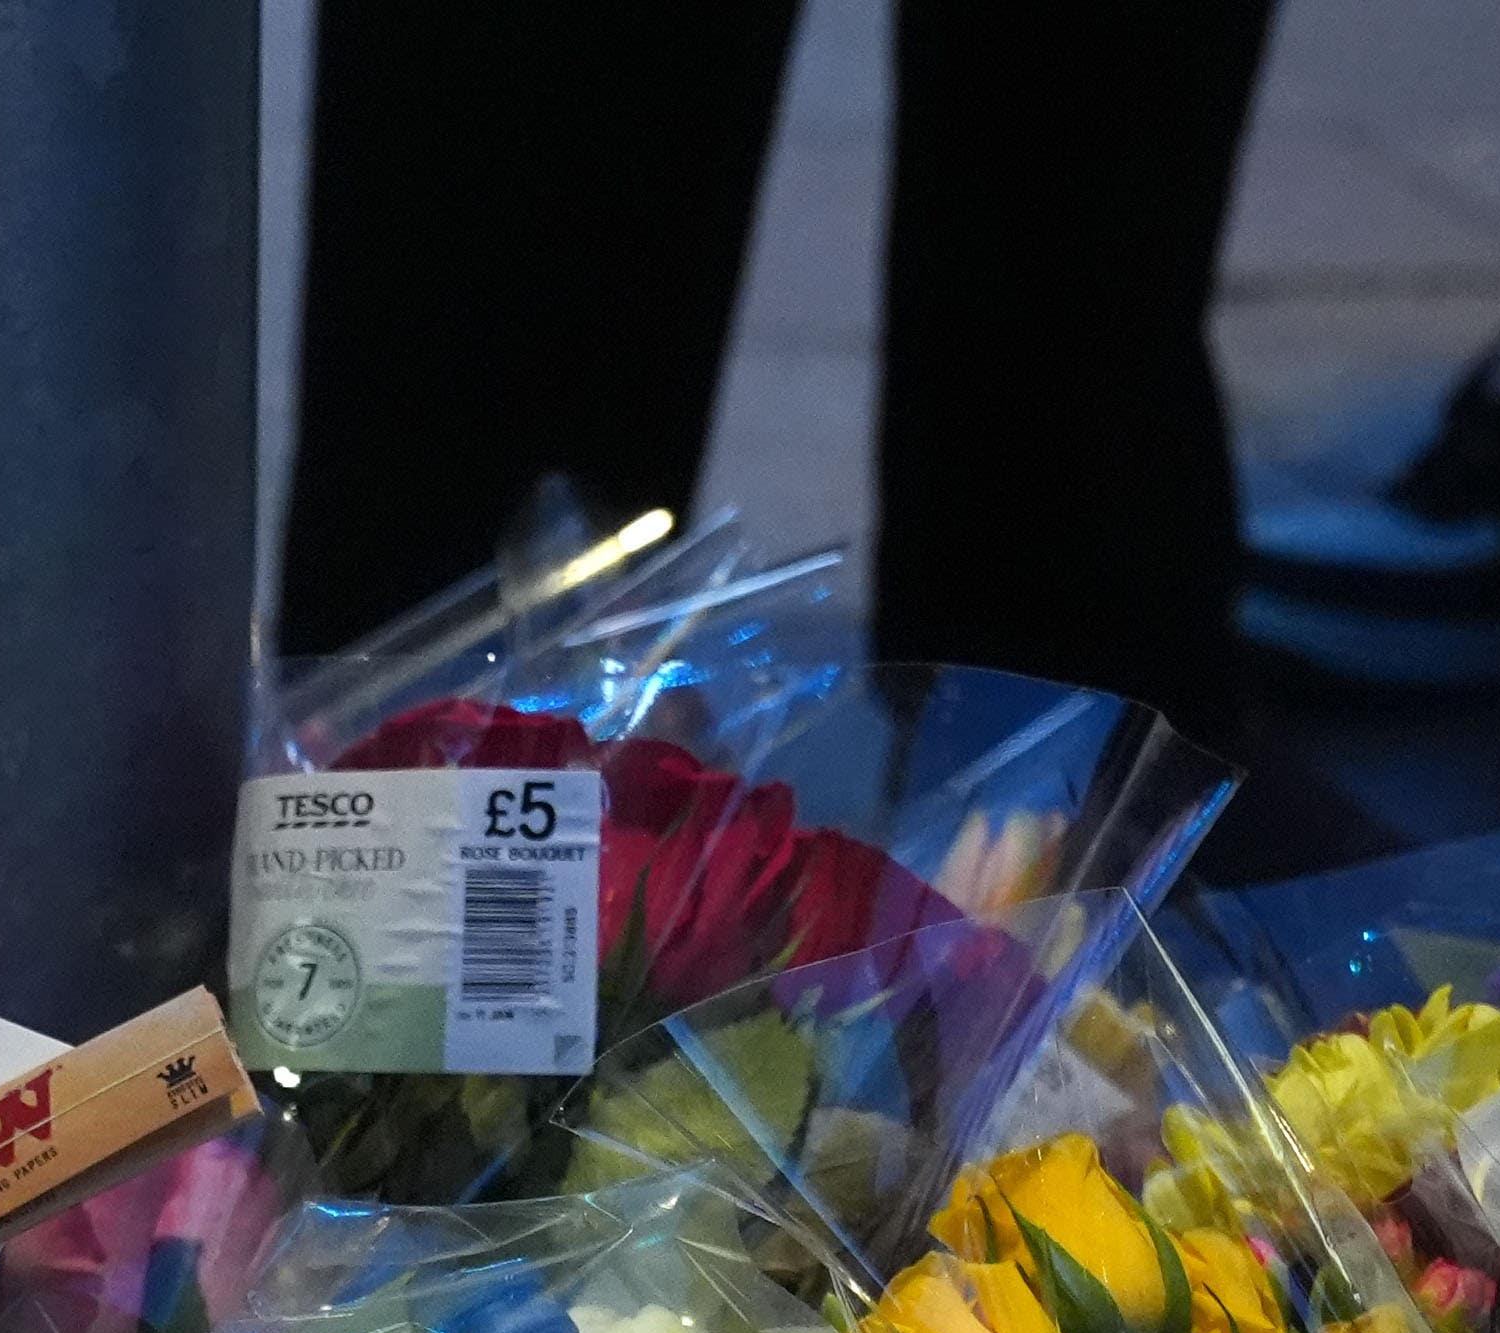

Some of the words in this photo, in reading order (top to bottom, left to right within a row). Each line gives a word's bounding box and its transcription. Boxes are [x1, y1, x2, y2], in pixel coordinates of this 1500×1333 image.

[277, 792, 375, 818] TESCO
[485, 781, 557, 842] £5
[299, 963, 319, 1001] 7
[13, 1146, 59, 1181] PAPERS
